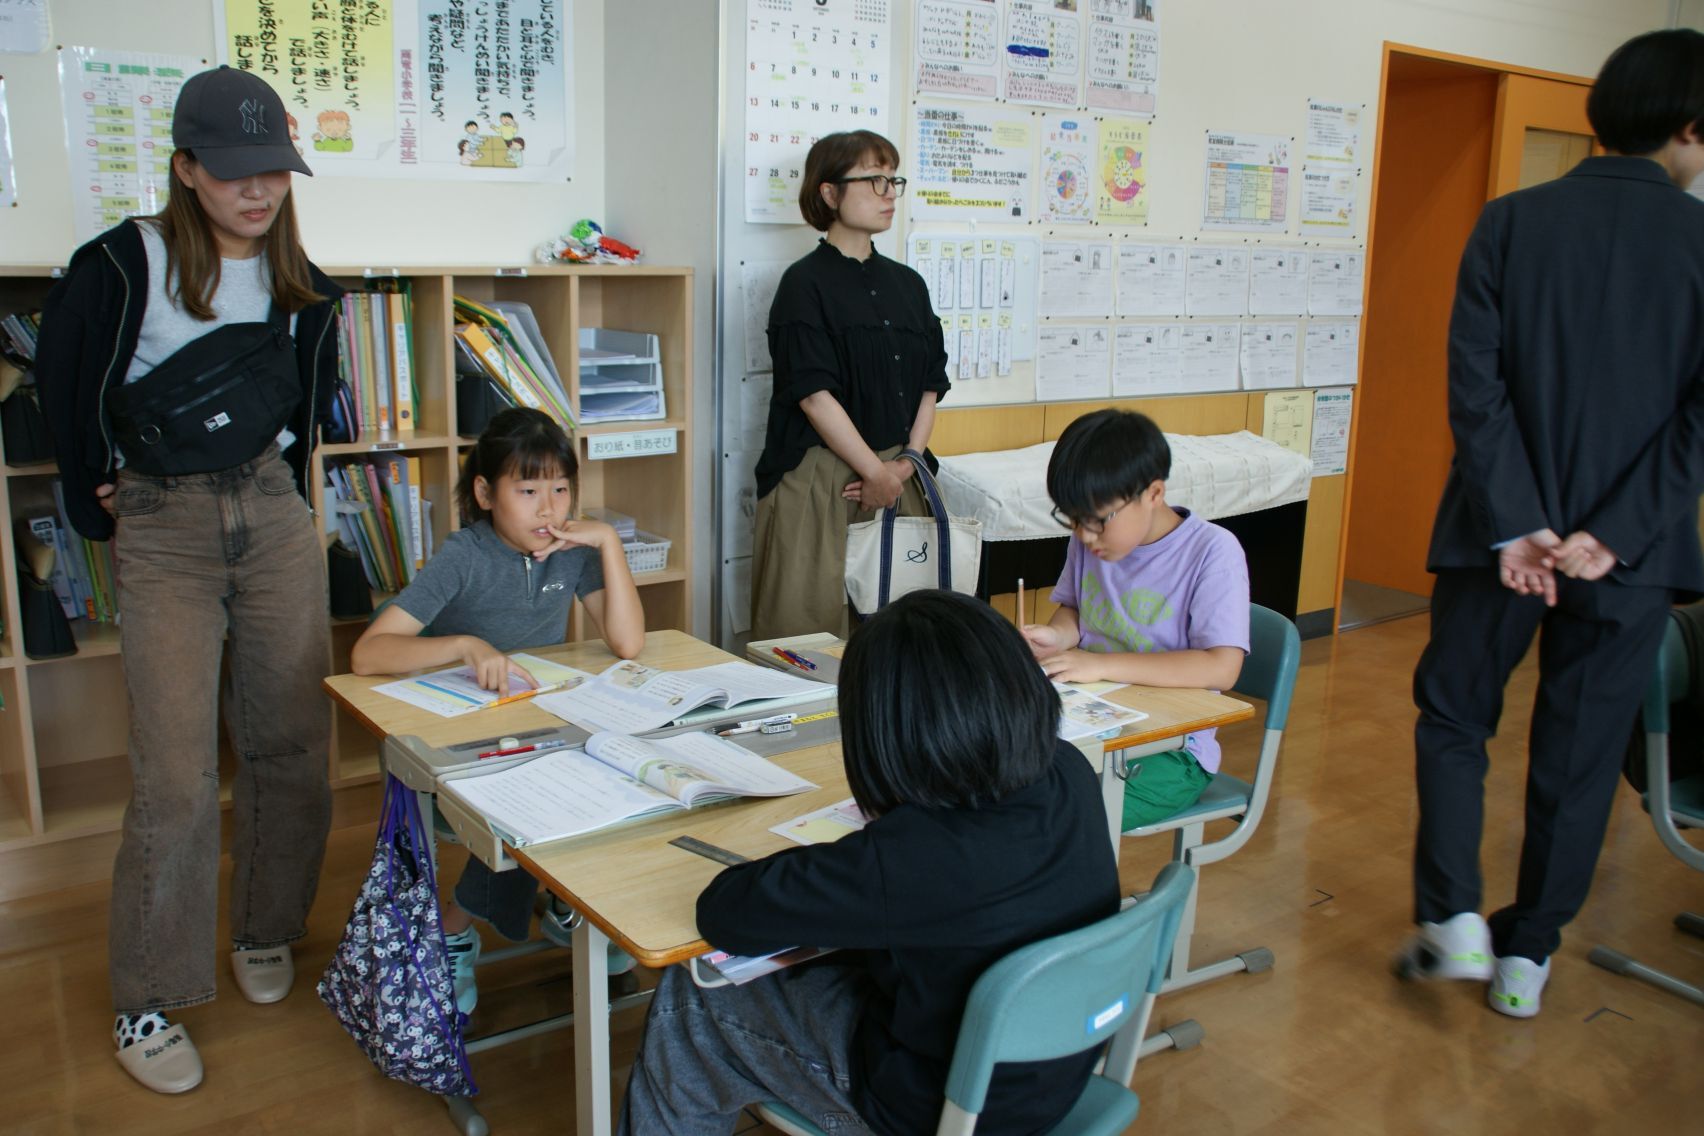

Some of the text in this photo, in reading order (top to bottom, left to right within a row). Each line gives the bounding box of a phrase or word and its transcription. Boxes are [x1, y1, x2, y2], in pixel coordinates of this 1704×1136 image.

[812, 33, 817, 41] 2
[832, 35, 837, 44] 3
[851, 38, 856, 46] 4
[870, 40, 876, 48] 5
[750, 62, 878, 82] 6 7 8 9 10 11 12
[750, 98, 878, 116] 13 14 15 16 17 18 19
[750, 133, 759, 141] 20
[770, 135, 779, 143] 21
[791, 136, 800, 144] 22
[750, 168, 799, 178] 27 28 29
